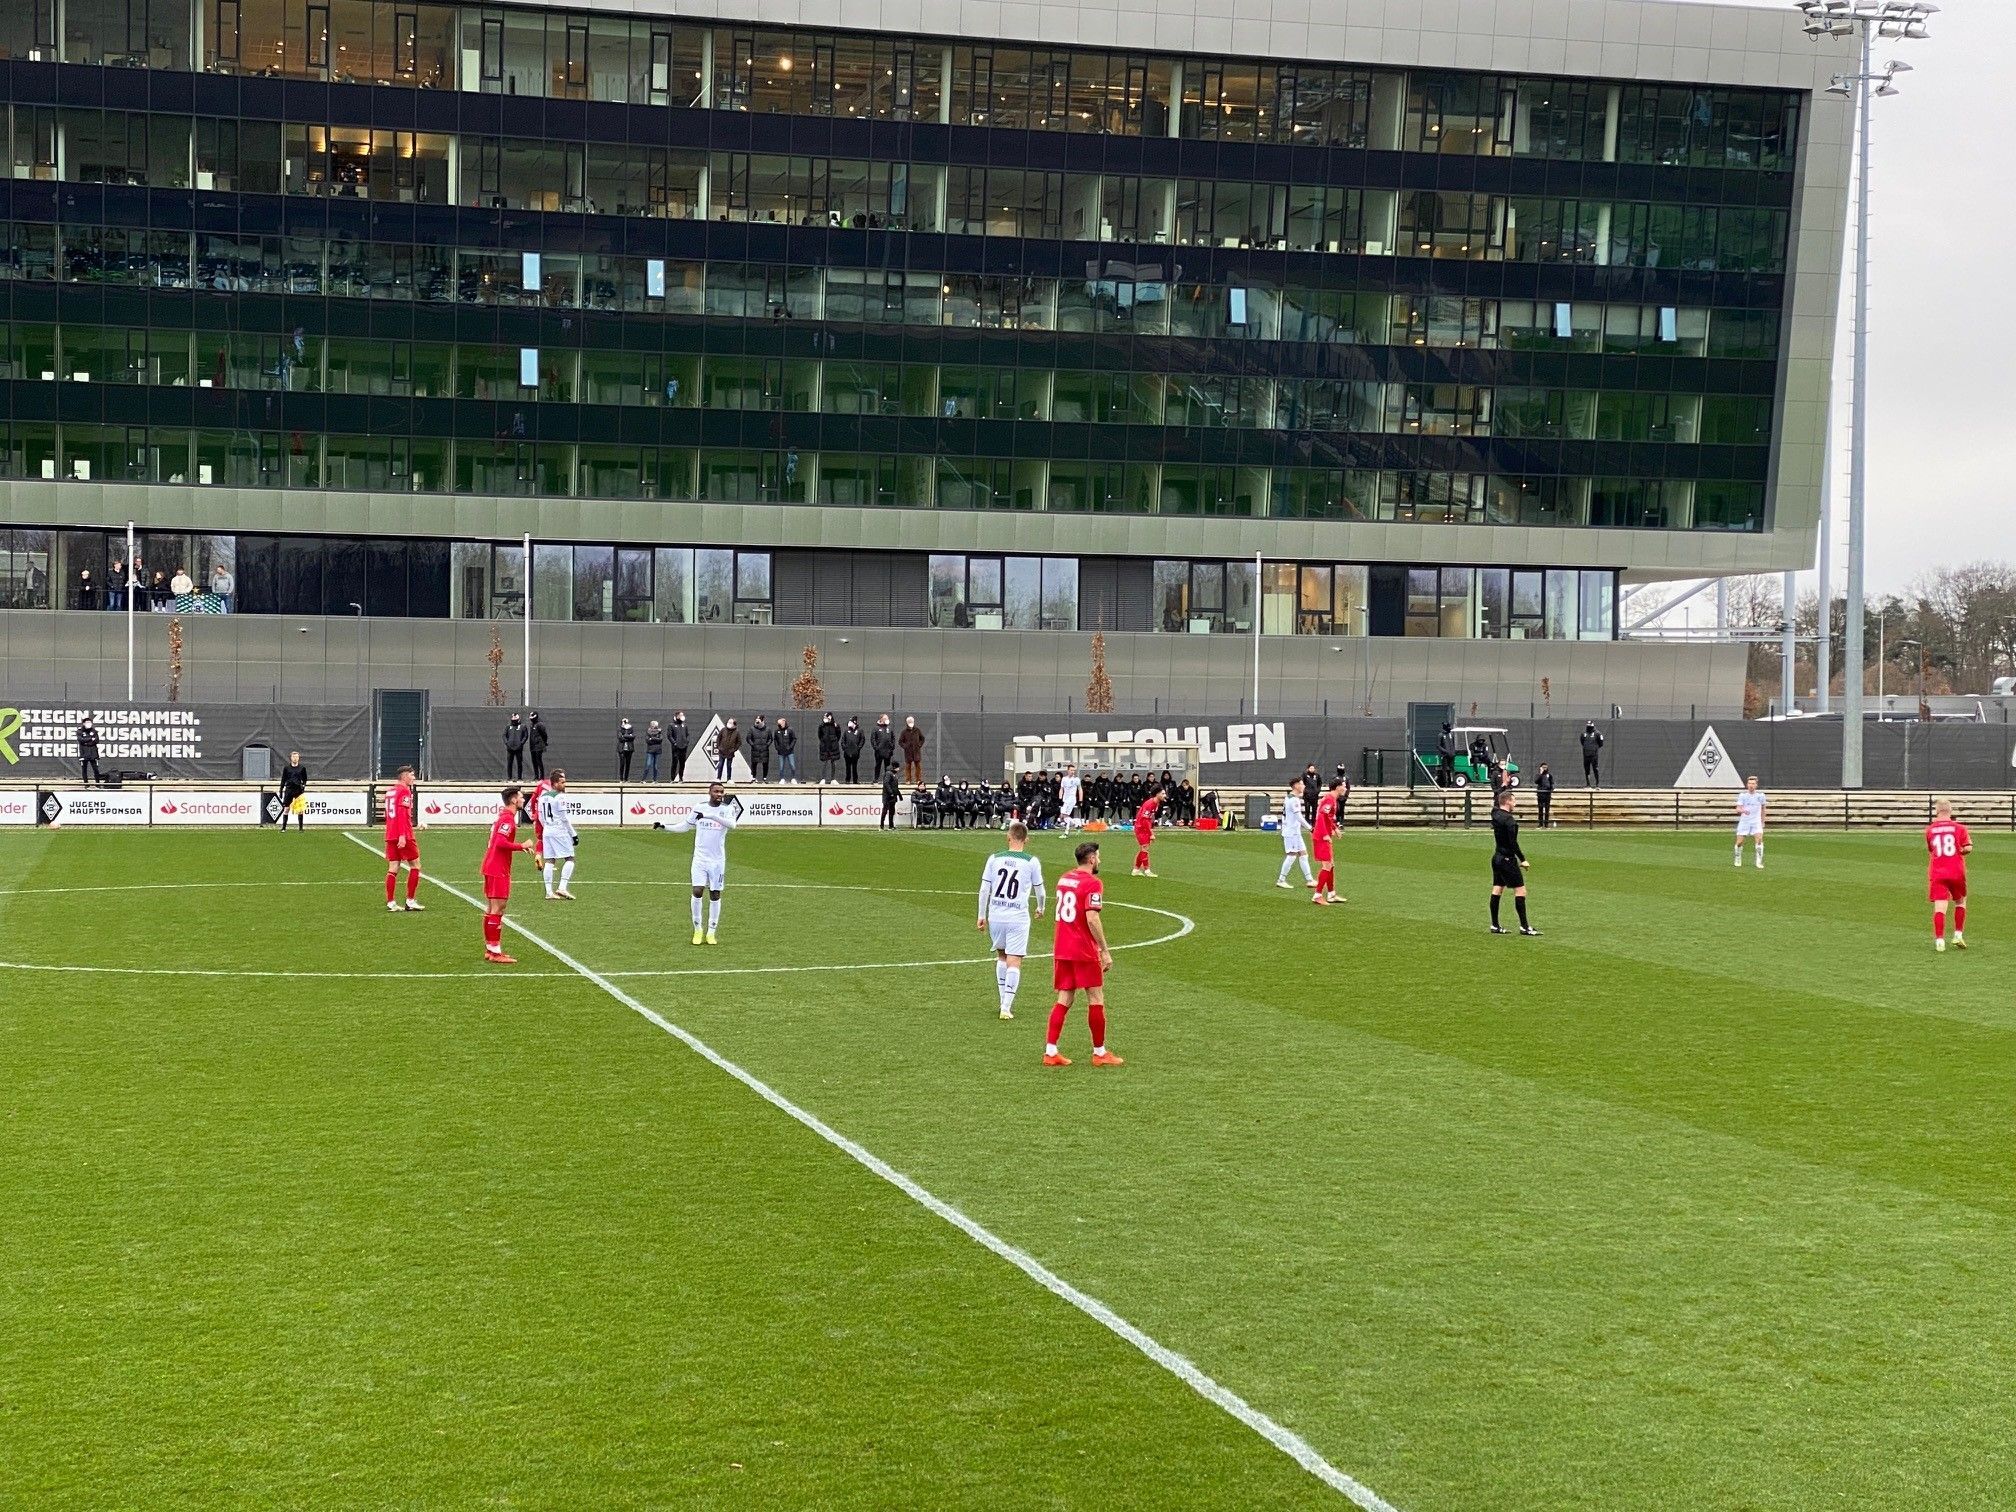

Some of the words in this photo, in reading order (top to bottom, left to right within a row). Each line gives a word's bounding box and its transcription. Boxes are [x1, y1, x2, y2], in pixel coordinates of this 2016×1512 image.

[92, 710, 200, 725] ZUSAMMEN.
[20, 726, 78, 740] LEIDE
[19, 743, 80, 758] STEHE
[180, 802, 252, 814] Santander
[543, 803, 554, 822] 14
[648, 803, 692, 815] Santan
[846, 804, 881, 816] Santa
[1931, 833, 1957, 857] 18
[995, 868, 1019, 900] 26
